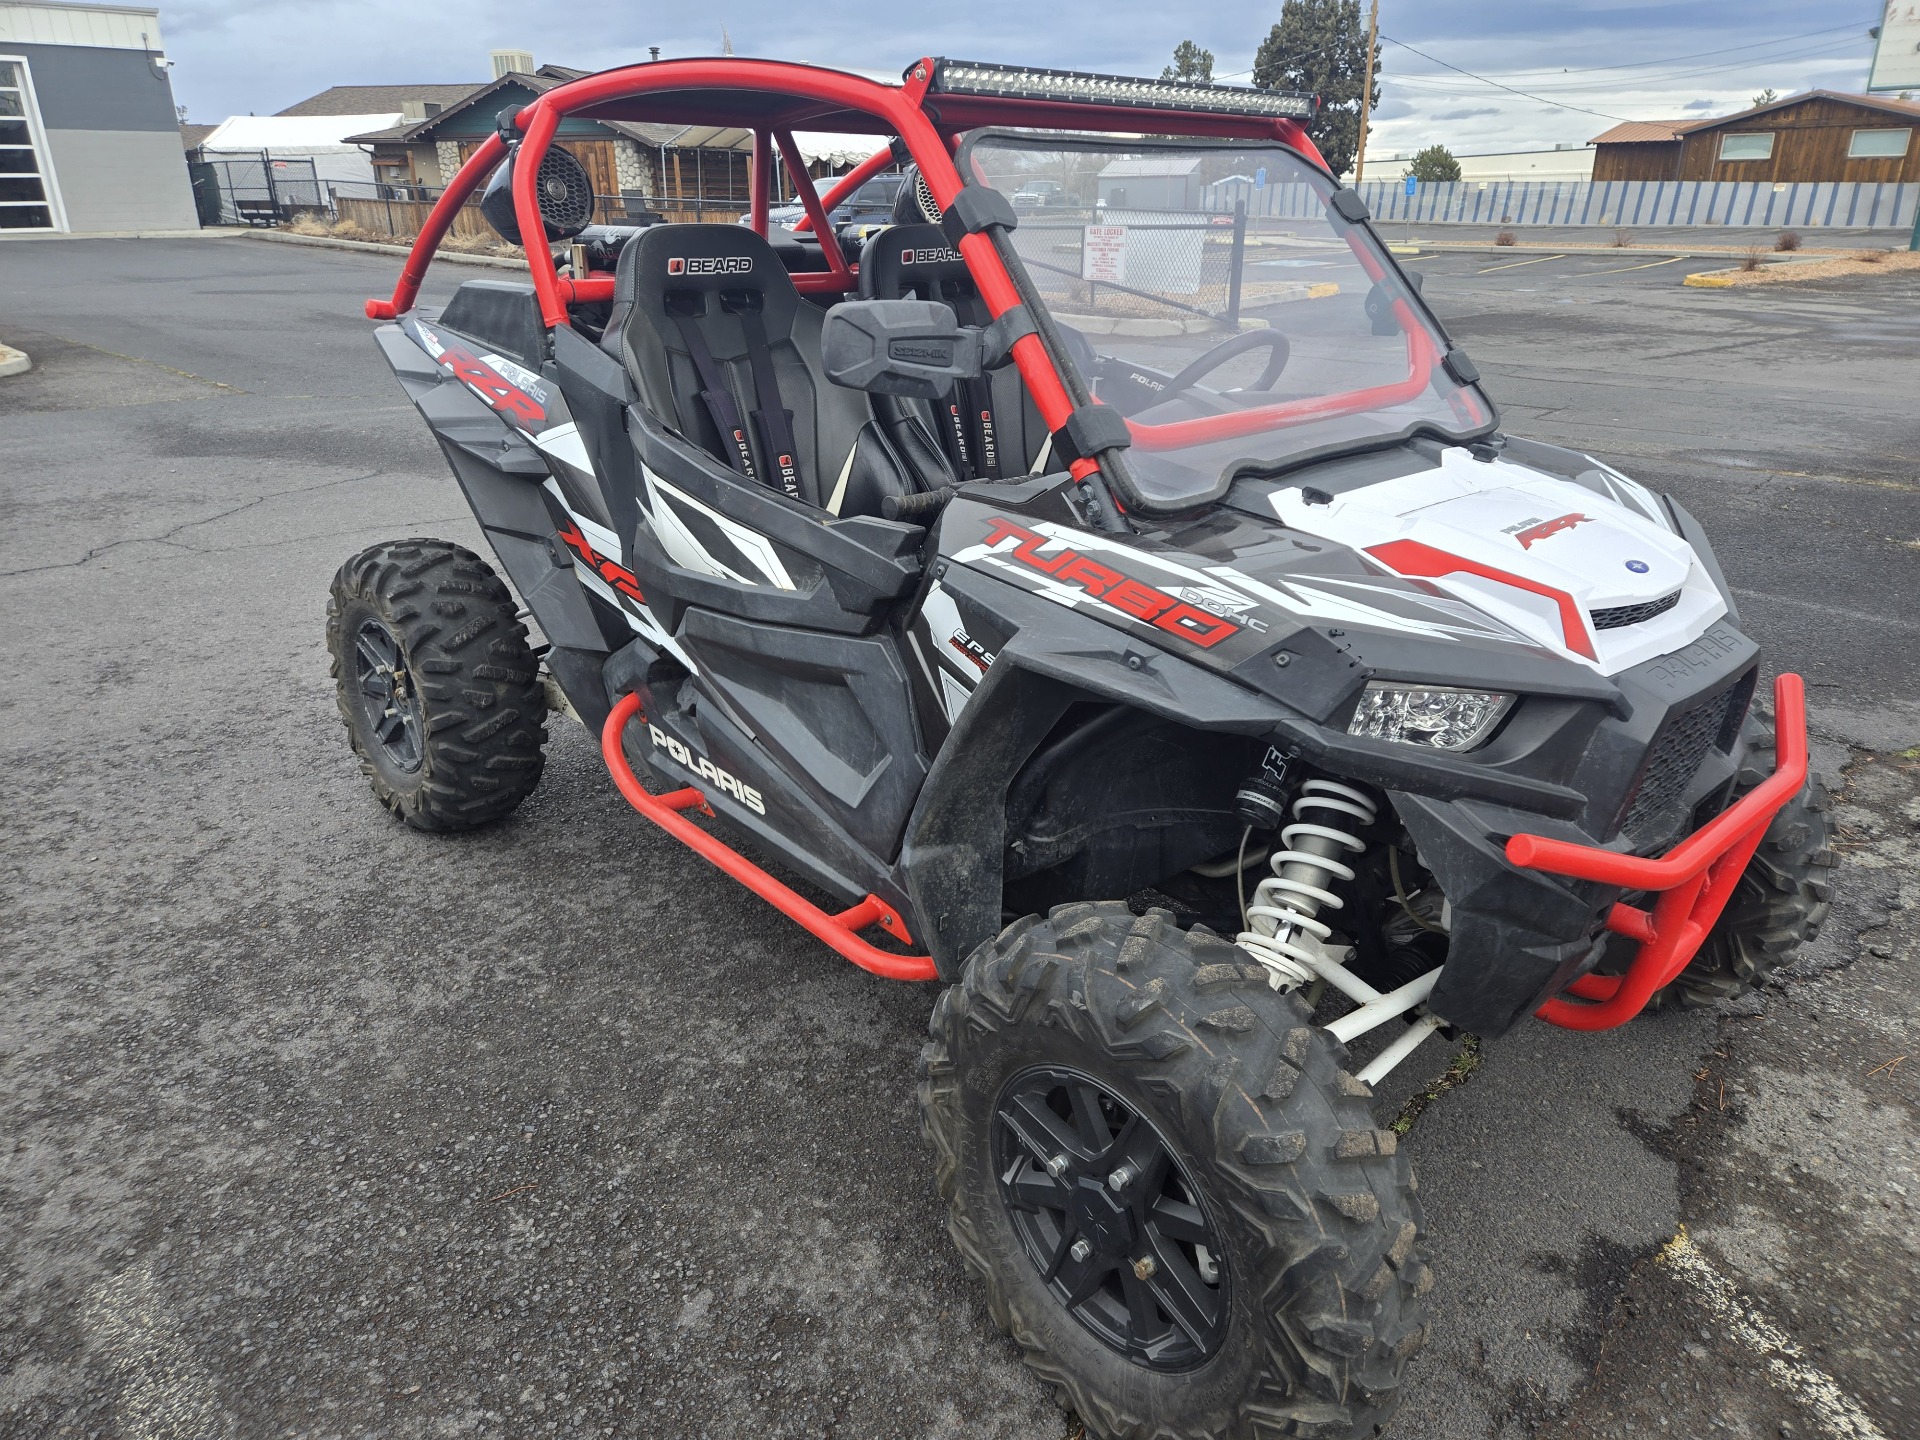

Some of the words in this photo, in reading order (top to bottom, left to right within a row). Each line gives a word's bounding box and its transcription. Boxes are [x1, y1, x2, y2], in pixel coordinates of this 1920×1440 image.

[687, 257, 753, 275] BEARD
[438, 343, 548, 435] RZR
[500, 361, 547, 404] POLARIS
[953, 416, 966, 453] BEARD
[983, 422, 995, 458] BEARD
[983, 516, 1240, 649] TURBO
[1180, 586, 1269, 634] DOHC
[953, 628, 996, 666] EPS
[1645, 629, 1743, 689] POLARIS
[649, 723, 766, 815] POLARIS
